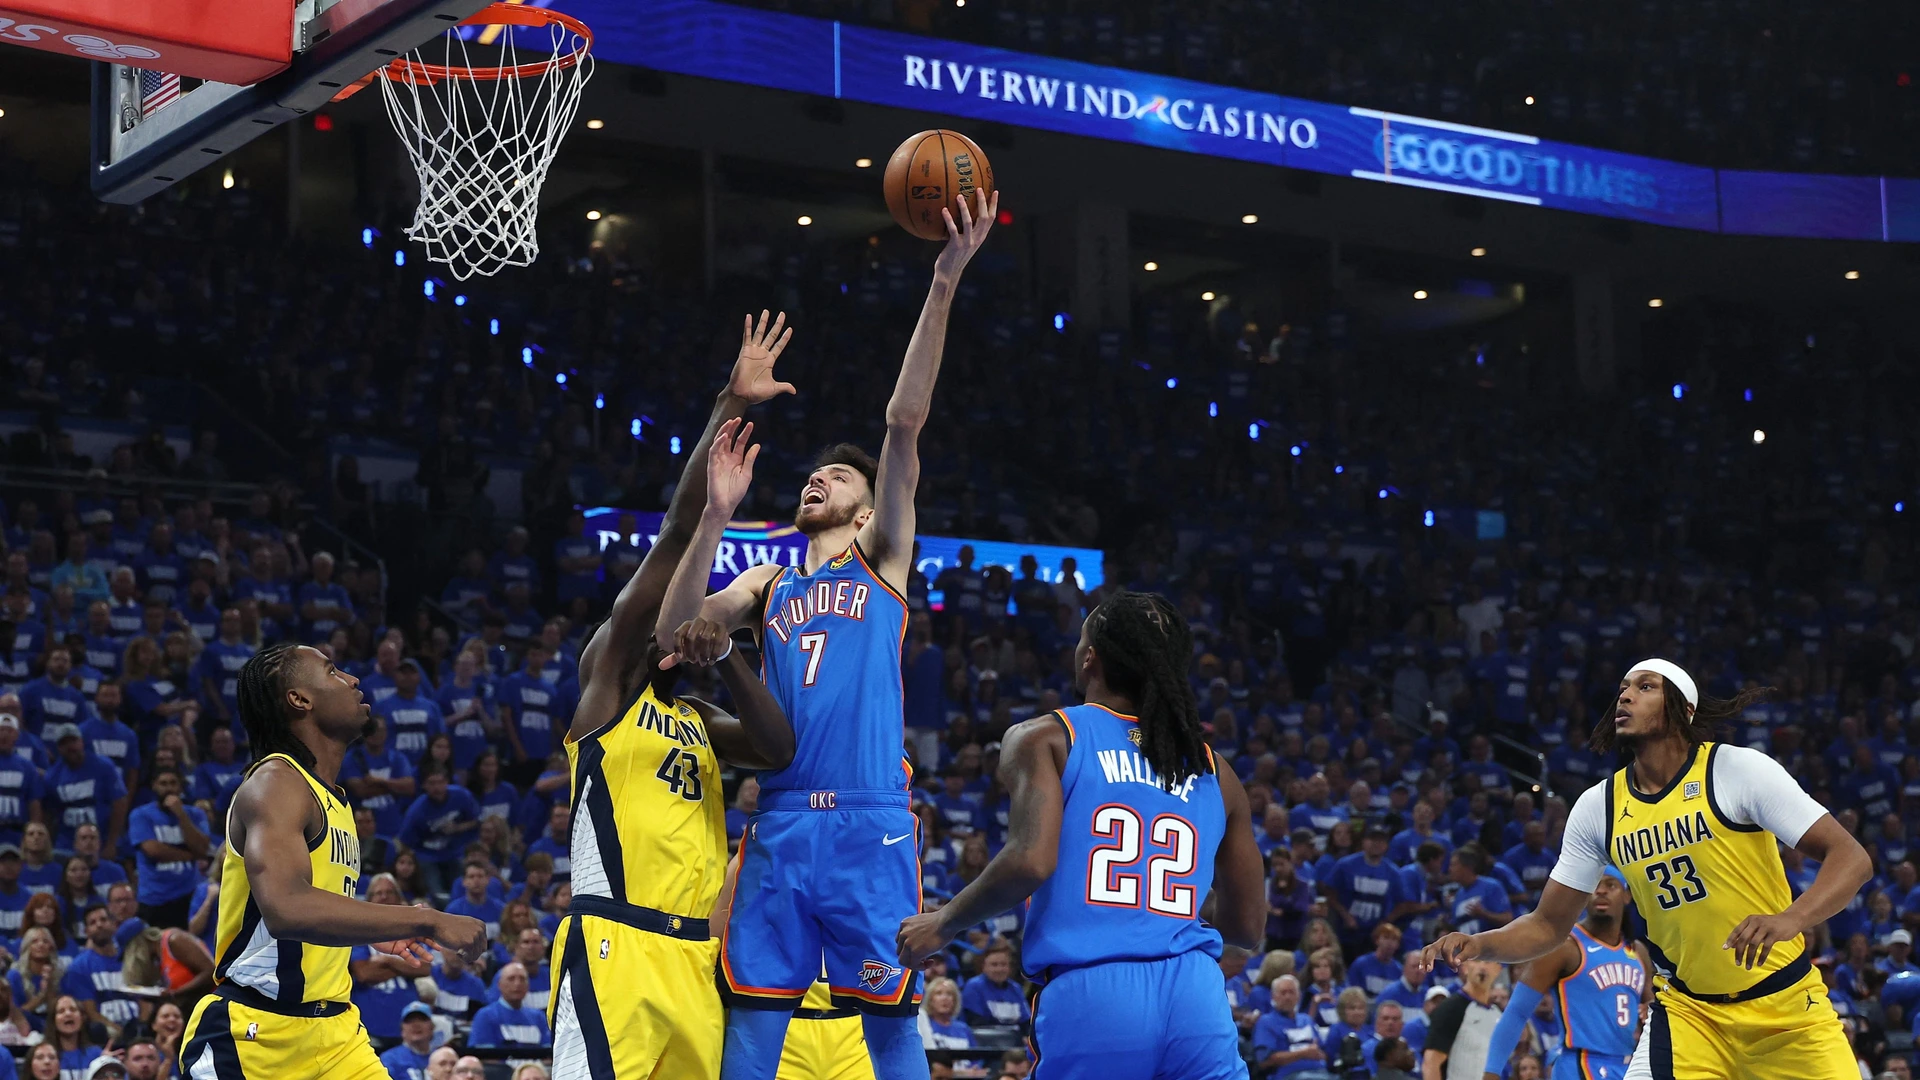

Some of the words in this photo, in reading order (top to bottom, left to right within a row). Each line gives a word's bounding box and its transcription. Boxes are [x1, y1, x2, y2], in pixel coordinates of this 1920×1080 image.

[903, 55, 1138, 119] RIVERWIND
[1170, 99, 1316, 149] CASINO
[1390, 132, 1524, 187] GOOD
[767, 580, 870, 644] THUNDER
[801, 630, 828, 687] 7
[656, 747, 703, 801] 43
[810, 792, 836, 808] OKC
[1086, 802, 1199, 920] 22
[1616, 810, 1713, 866] INDIANA
[1645, 855, 1708, 910] 33
[863, 969, 883, 981] OKC
[1616, 993, 1630, 1027] 5
